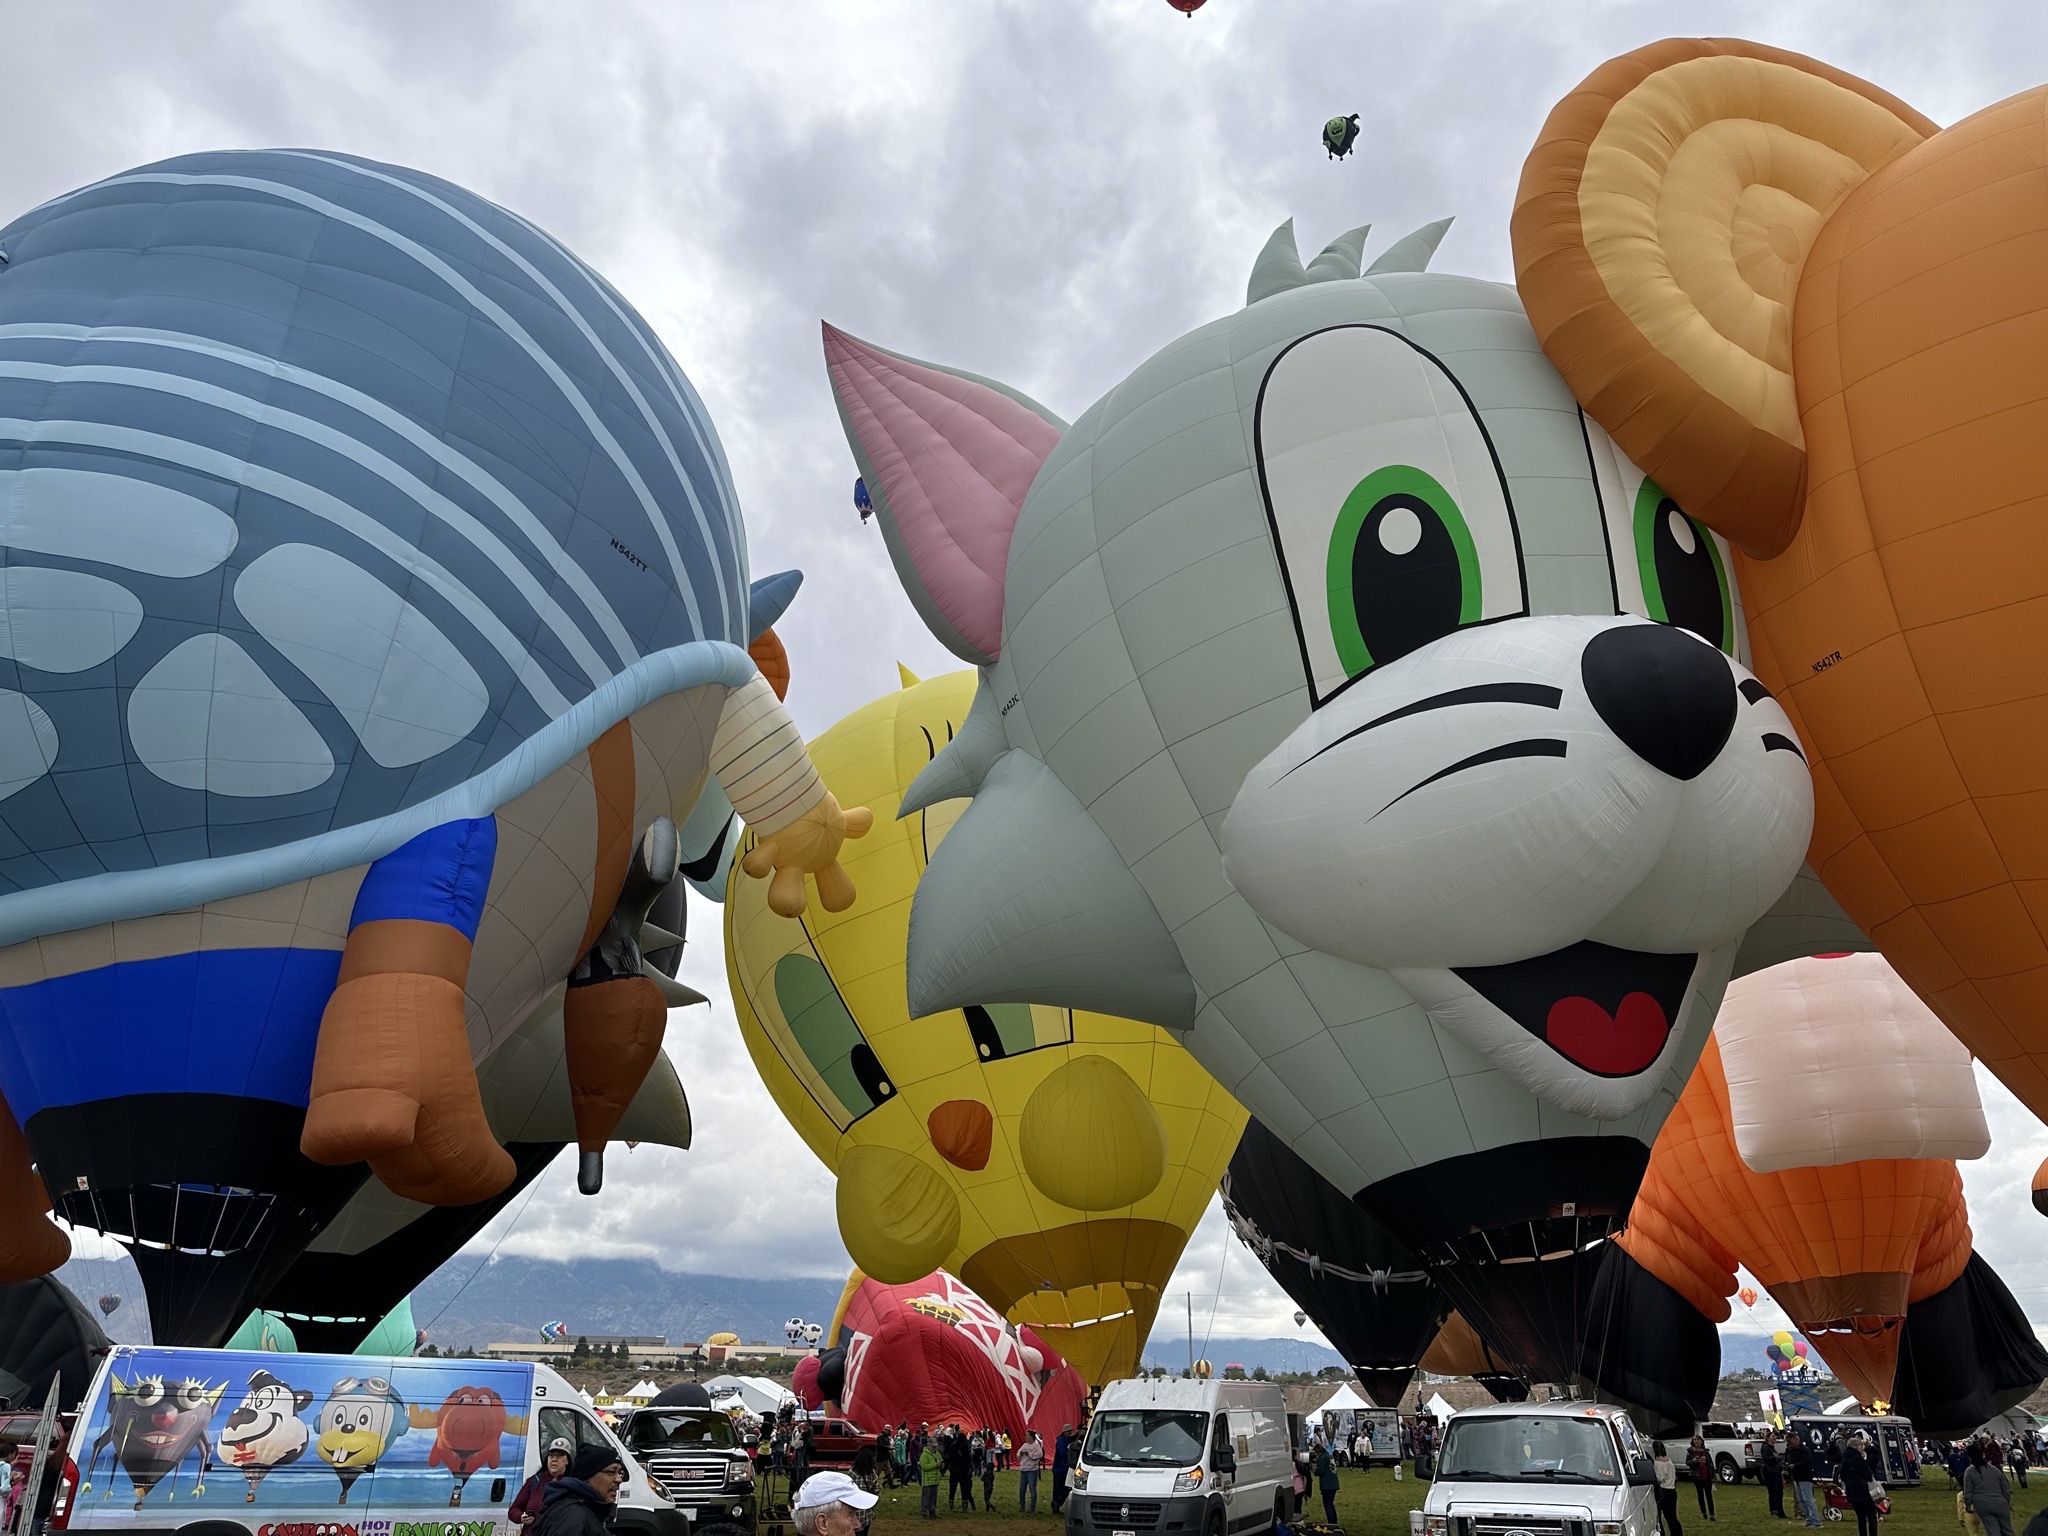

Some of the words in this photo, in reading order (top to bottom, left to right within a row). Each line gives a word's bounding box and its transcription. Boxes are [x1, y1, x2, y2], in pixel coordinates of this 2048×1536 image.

[610, 538, 648, 572] N542TT
[1811, 650, 1843, 673] N542TR
[535, 1386, 547, 1397] 3
[672, 1470, 705, 1479] GMC
[258, 1522, 360, 1536] CARTOON
[362, 1521, 392, 1531] HOT
